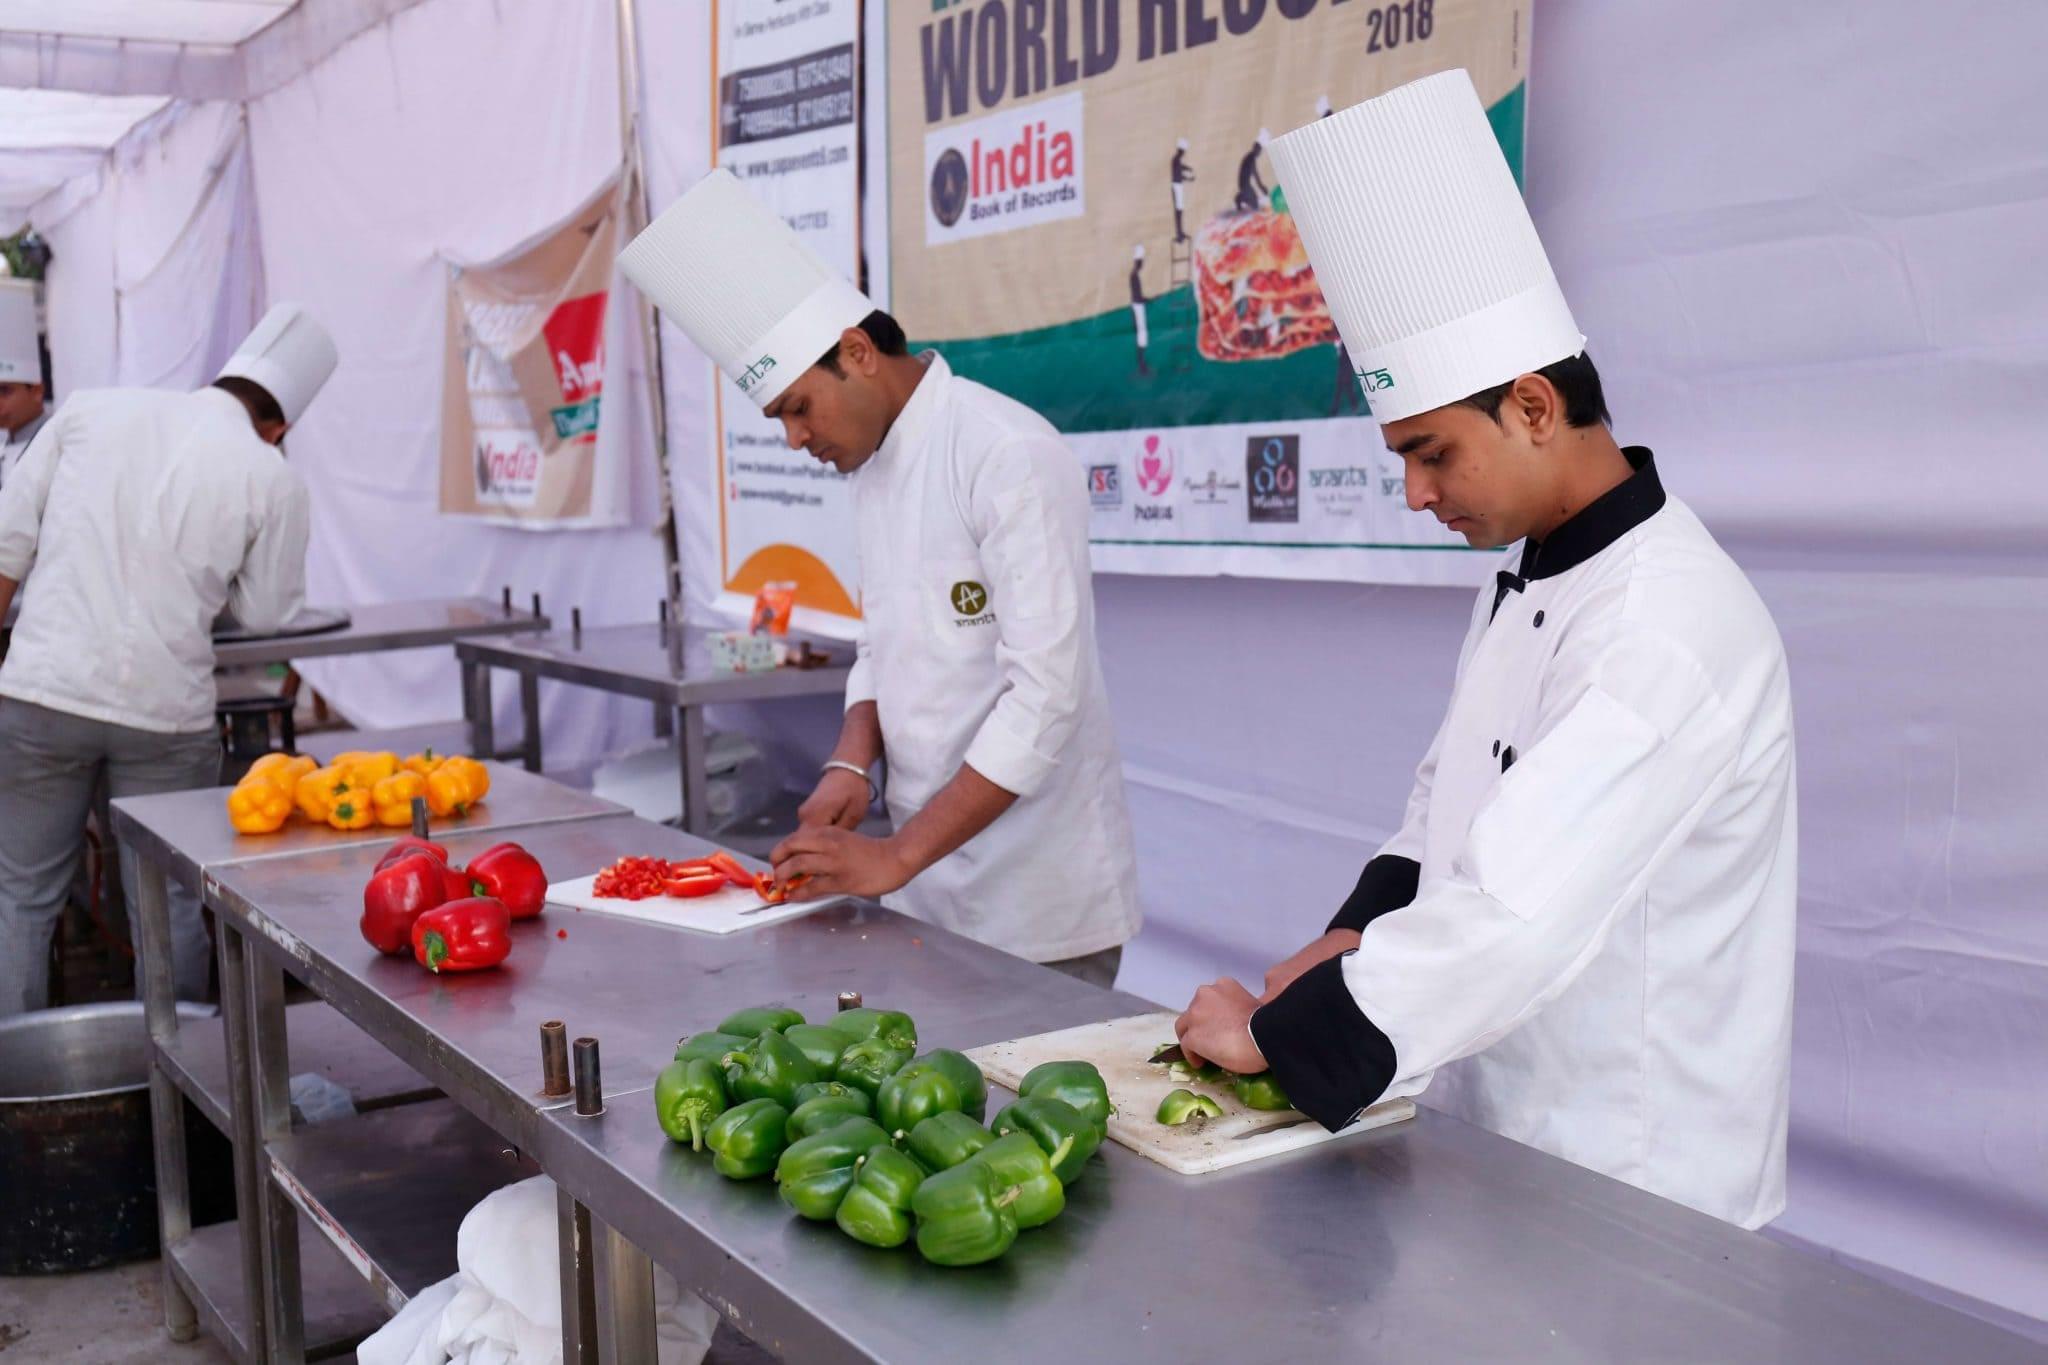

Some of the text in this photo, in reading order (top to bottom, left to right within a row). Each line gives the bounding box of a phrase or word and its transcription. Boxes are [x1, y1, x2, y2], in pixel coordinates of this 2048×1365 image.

[1367, 0, 1432, 54] 2018
[921, 0, 1120, 124] WORLD
[971, 121, 1074, 198] India
[970, 183, 1076, 221] Book of Records
